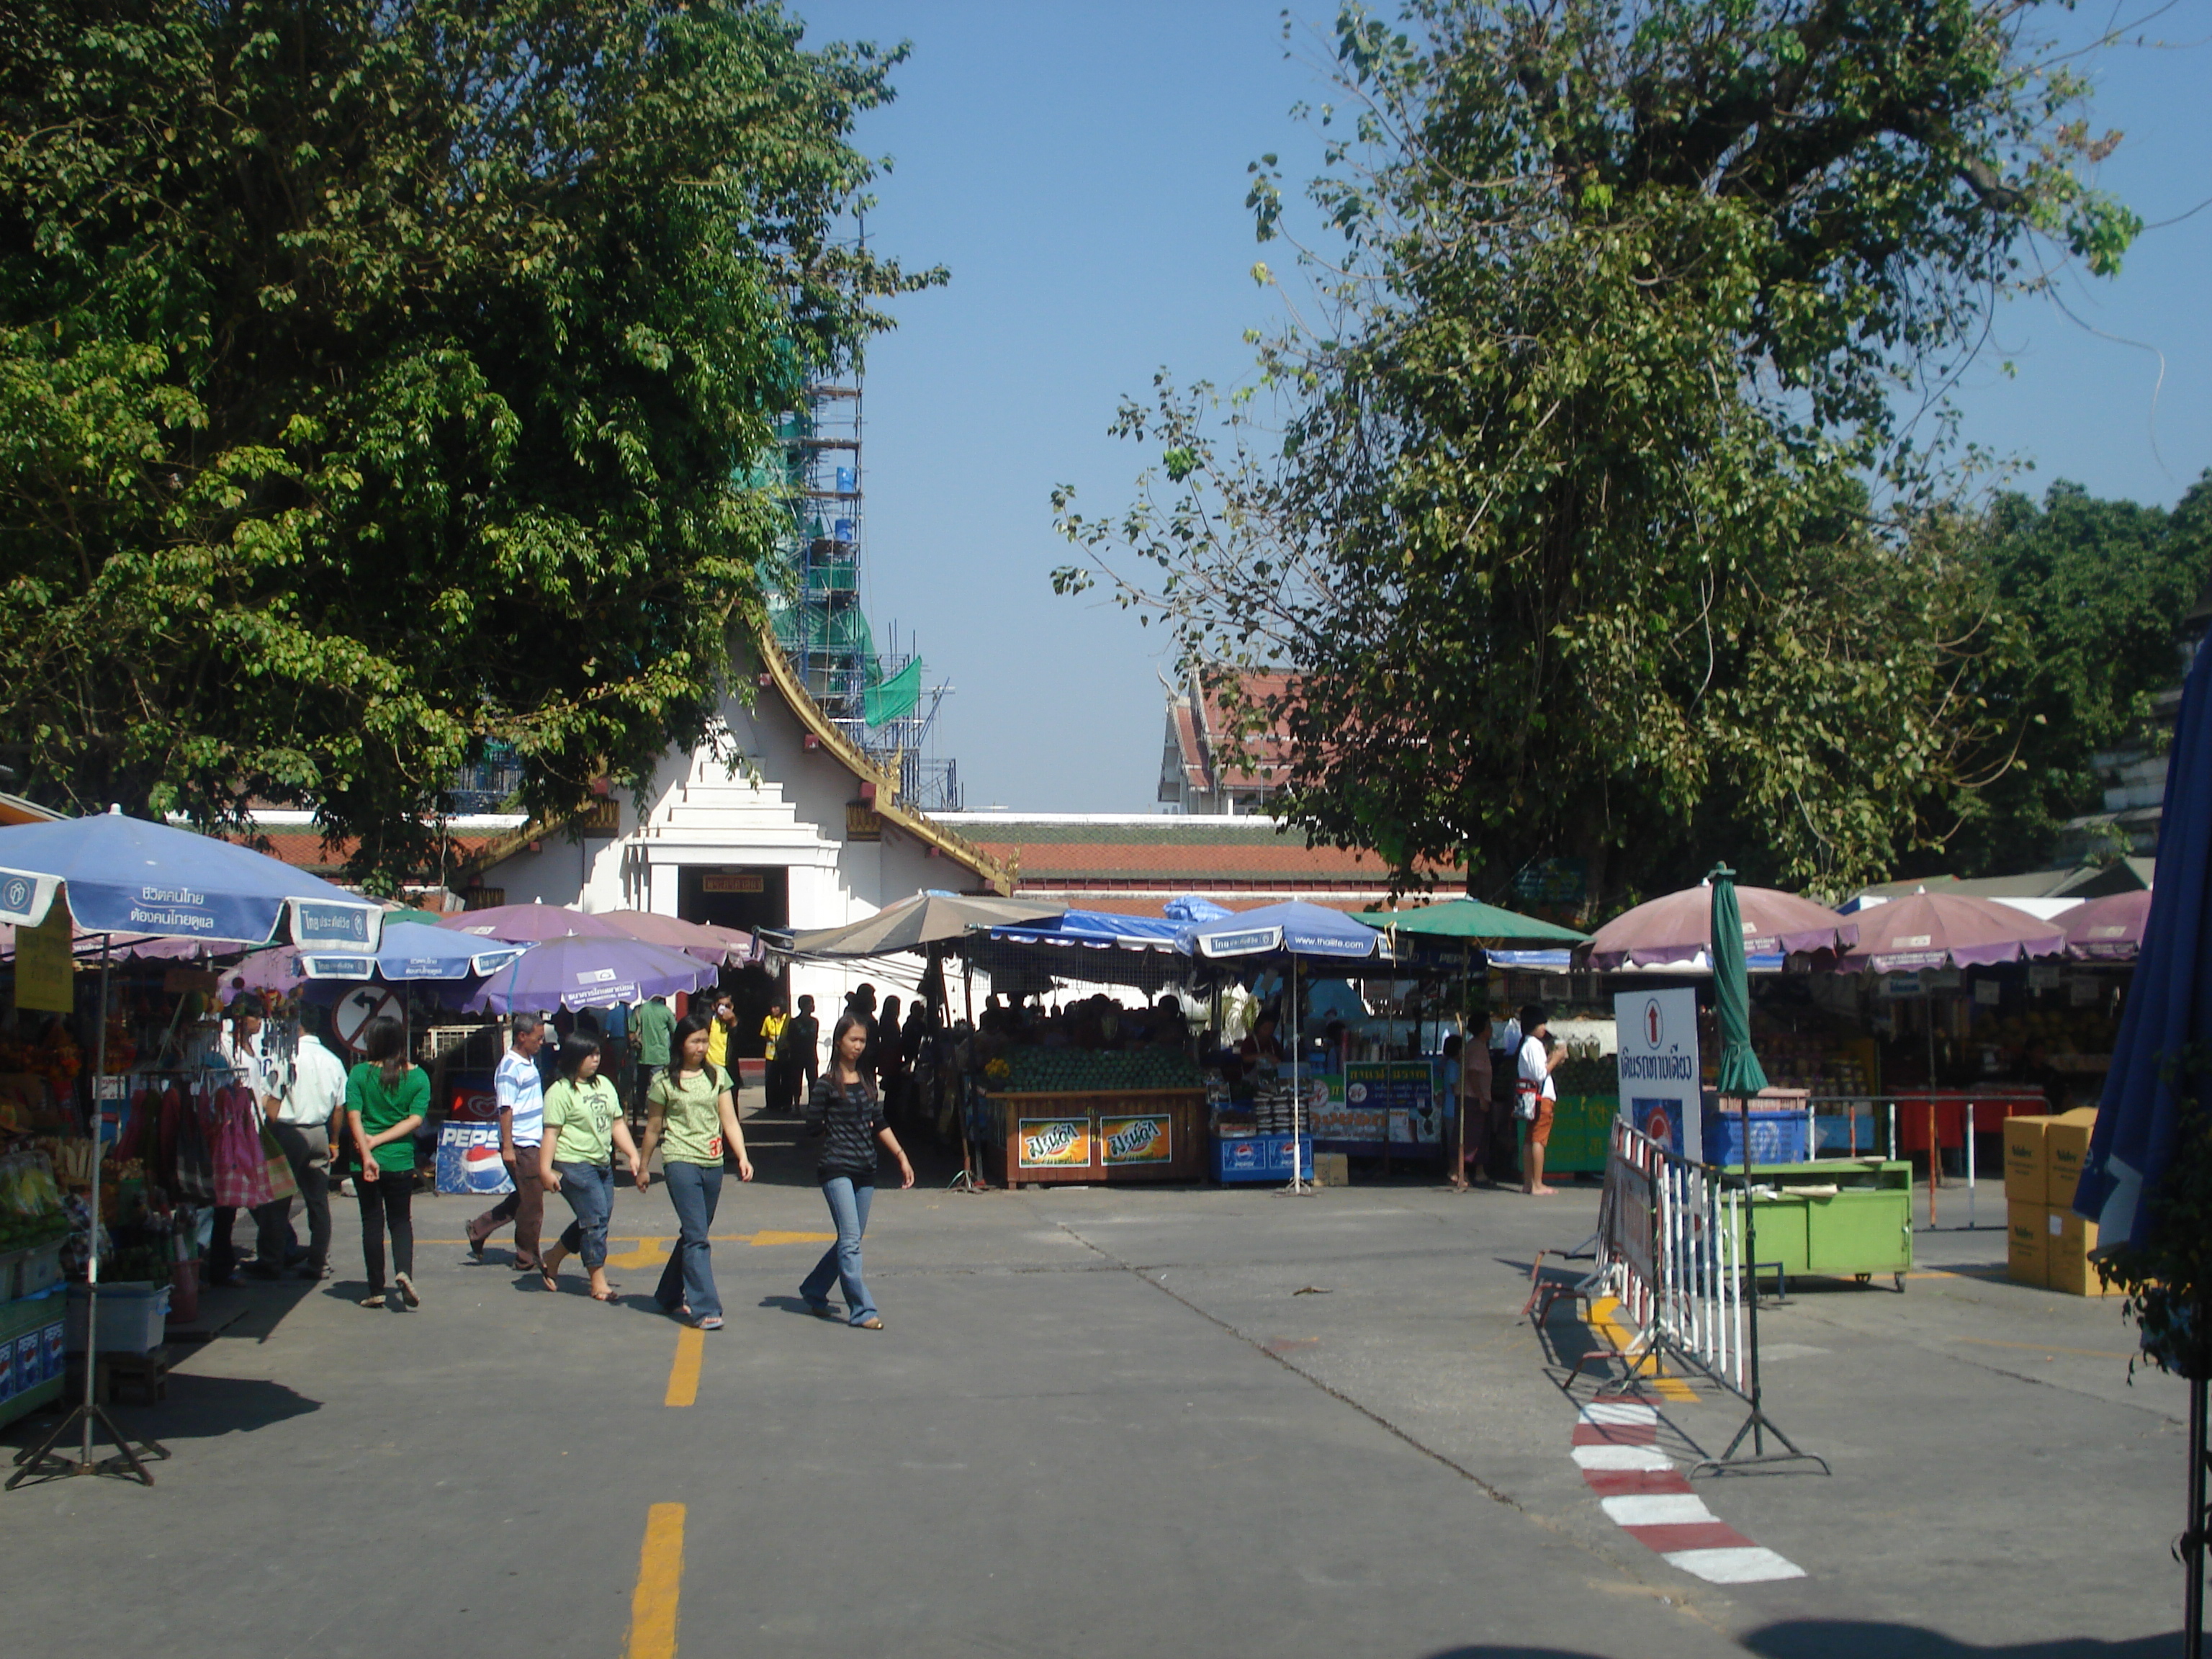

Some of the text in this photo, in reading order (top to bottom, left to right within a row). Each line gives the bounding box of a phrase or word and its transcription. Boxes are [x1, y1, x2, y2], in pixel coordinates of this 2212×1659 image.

[142, 886, 204, 905] ชีวิตคนไทย
[130, 907, 214, 931] ต้องคนไทยดูแล
[1620, 1043, 1692, 1080] เดินรถทางเดียว
[441, 1127, 501, 1149] PEPS
